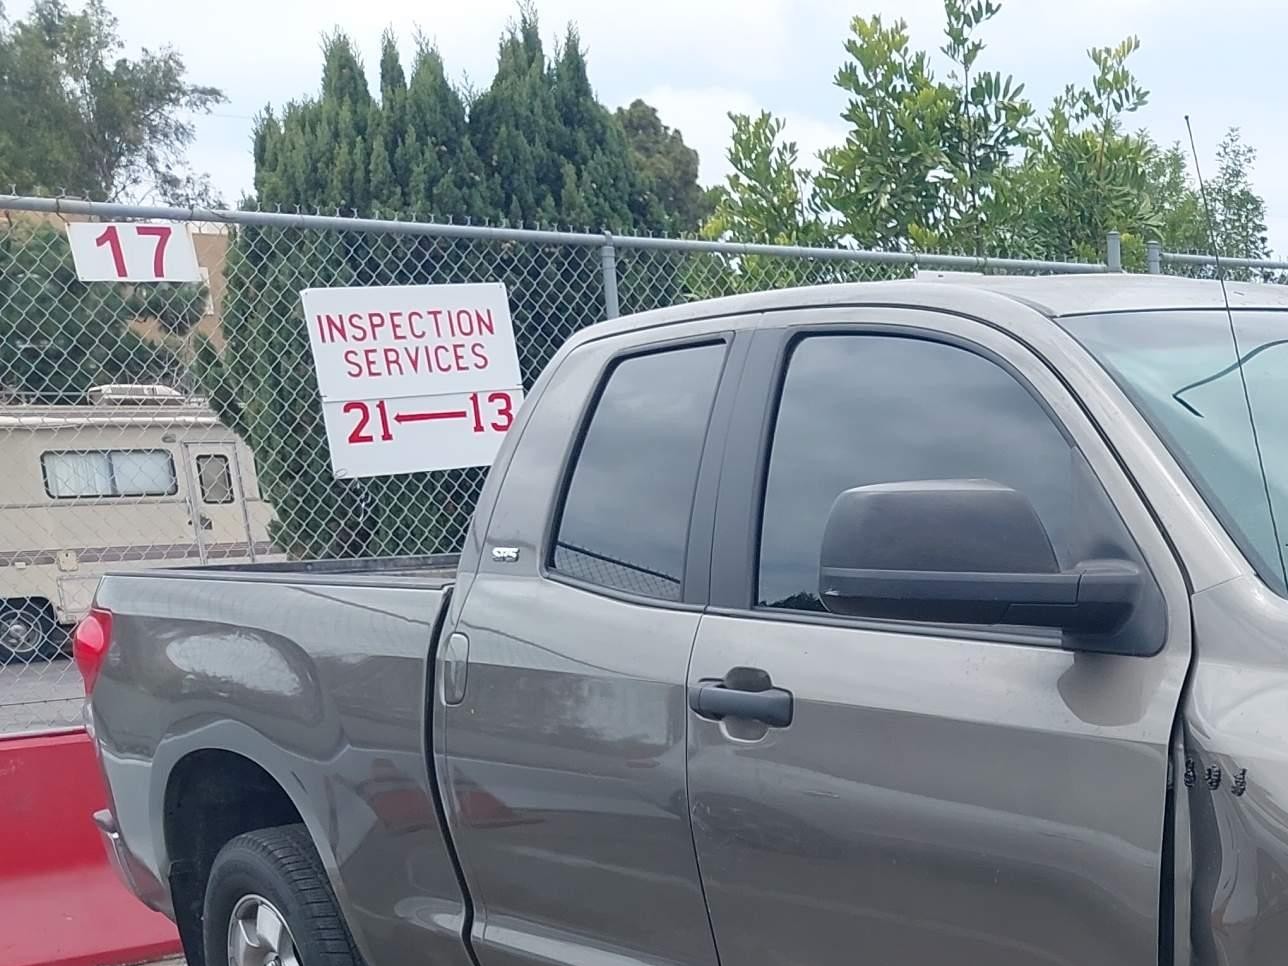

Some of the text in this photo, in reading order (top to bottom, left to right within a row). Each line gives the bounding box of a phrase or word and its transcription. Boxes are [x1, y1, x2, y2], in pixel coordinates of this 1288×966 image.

[95, 225, 172, 278] 17
[316, 308, 495, 344] INSPECTION
[343, 342, 489, 378] SERVICES
[343, 391, 514, 444] 21 13
